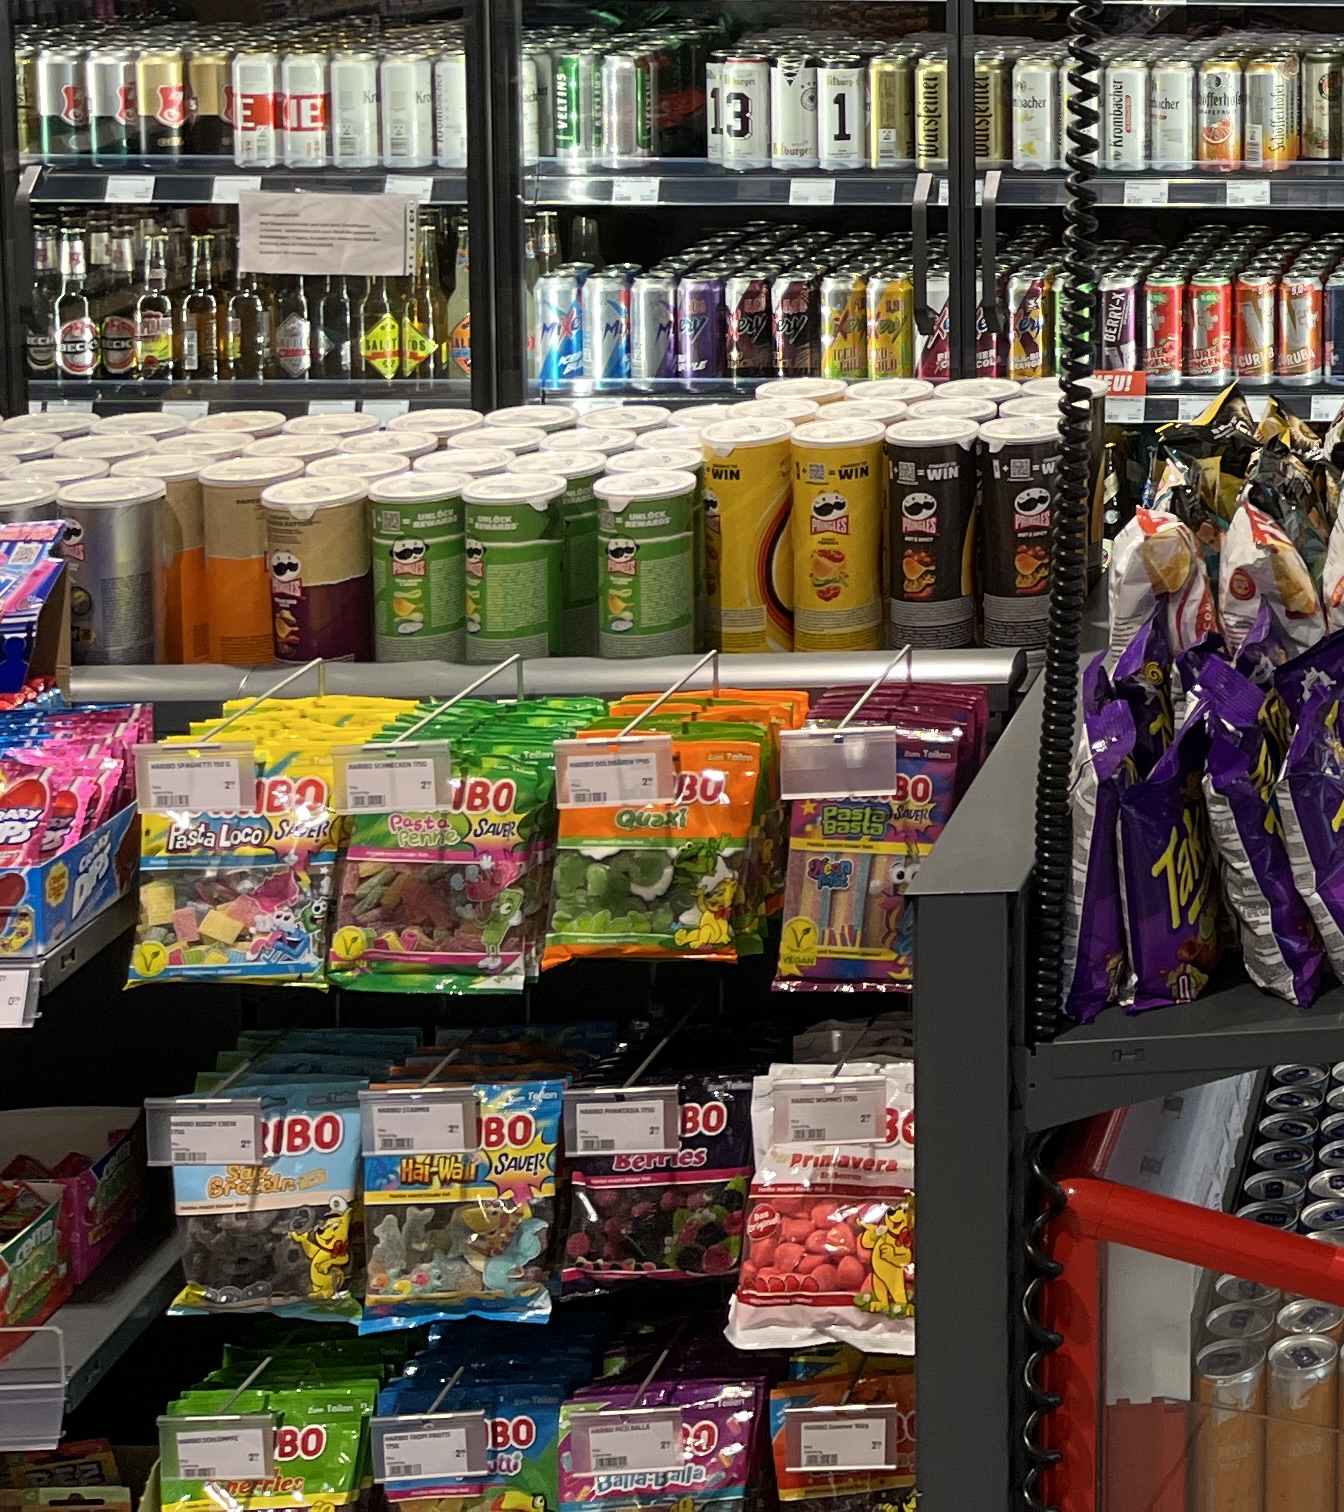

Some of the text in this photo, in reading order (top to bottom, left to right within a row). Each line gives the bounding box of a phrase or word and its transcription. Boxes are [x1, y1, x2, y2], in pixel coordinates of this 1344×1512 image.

[557, 73, 568, 131] VELTINS
[726, 92, 753, 140] 3
[832, 93, 852, 141] 1
[1111, 78, 1124, 149] Krombacher
[1104, 290, 1127, 344] BERRY-X
[1099, 374, 1133, 392] EU!
[712, 466, 741, 481] WIN
[837, 465, 871, 481] WIN
[926, 465, 960, 481] WIN
[811, 518, 848, 534] PRINGLES
[902, 518, 938, 535] PRINGLES
[390, 815, 451, 832] Pasta
[615, 807, 689, 831] Quaxi
[822, 805, 887, 824] Pasta
[168, 820, 265, 851] Pasta Loco
[822, 819, 885, 836] Basta
[789, 1152, 899, 1173] Primavera
